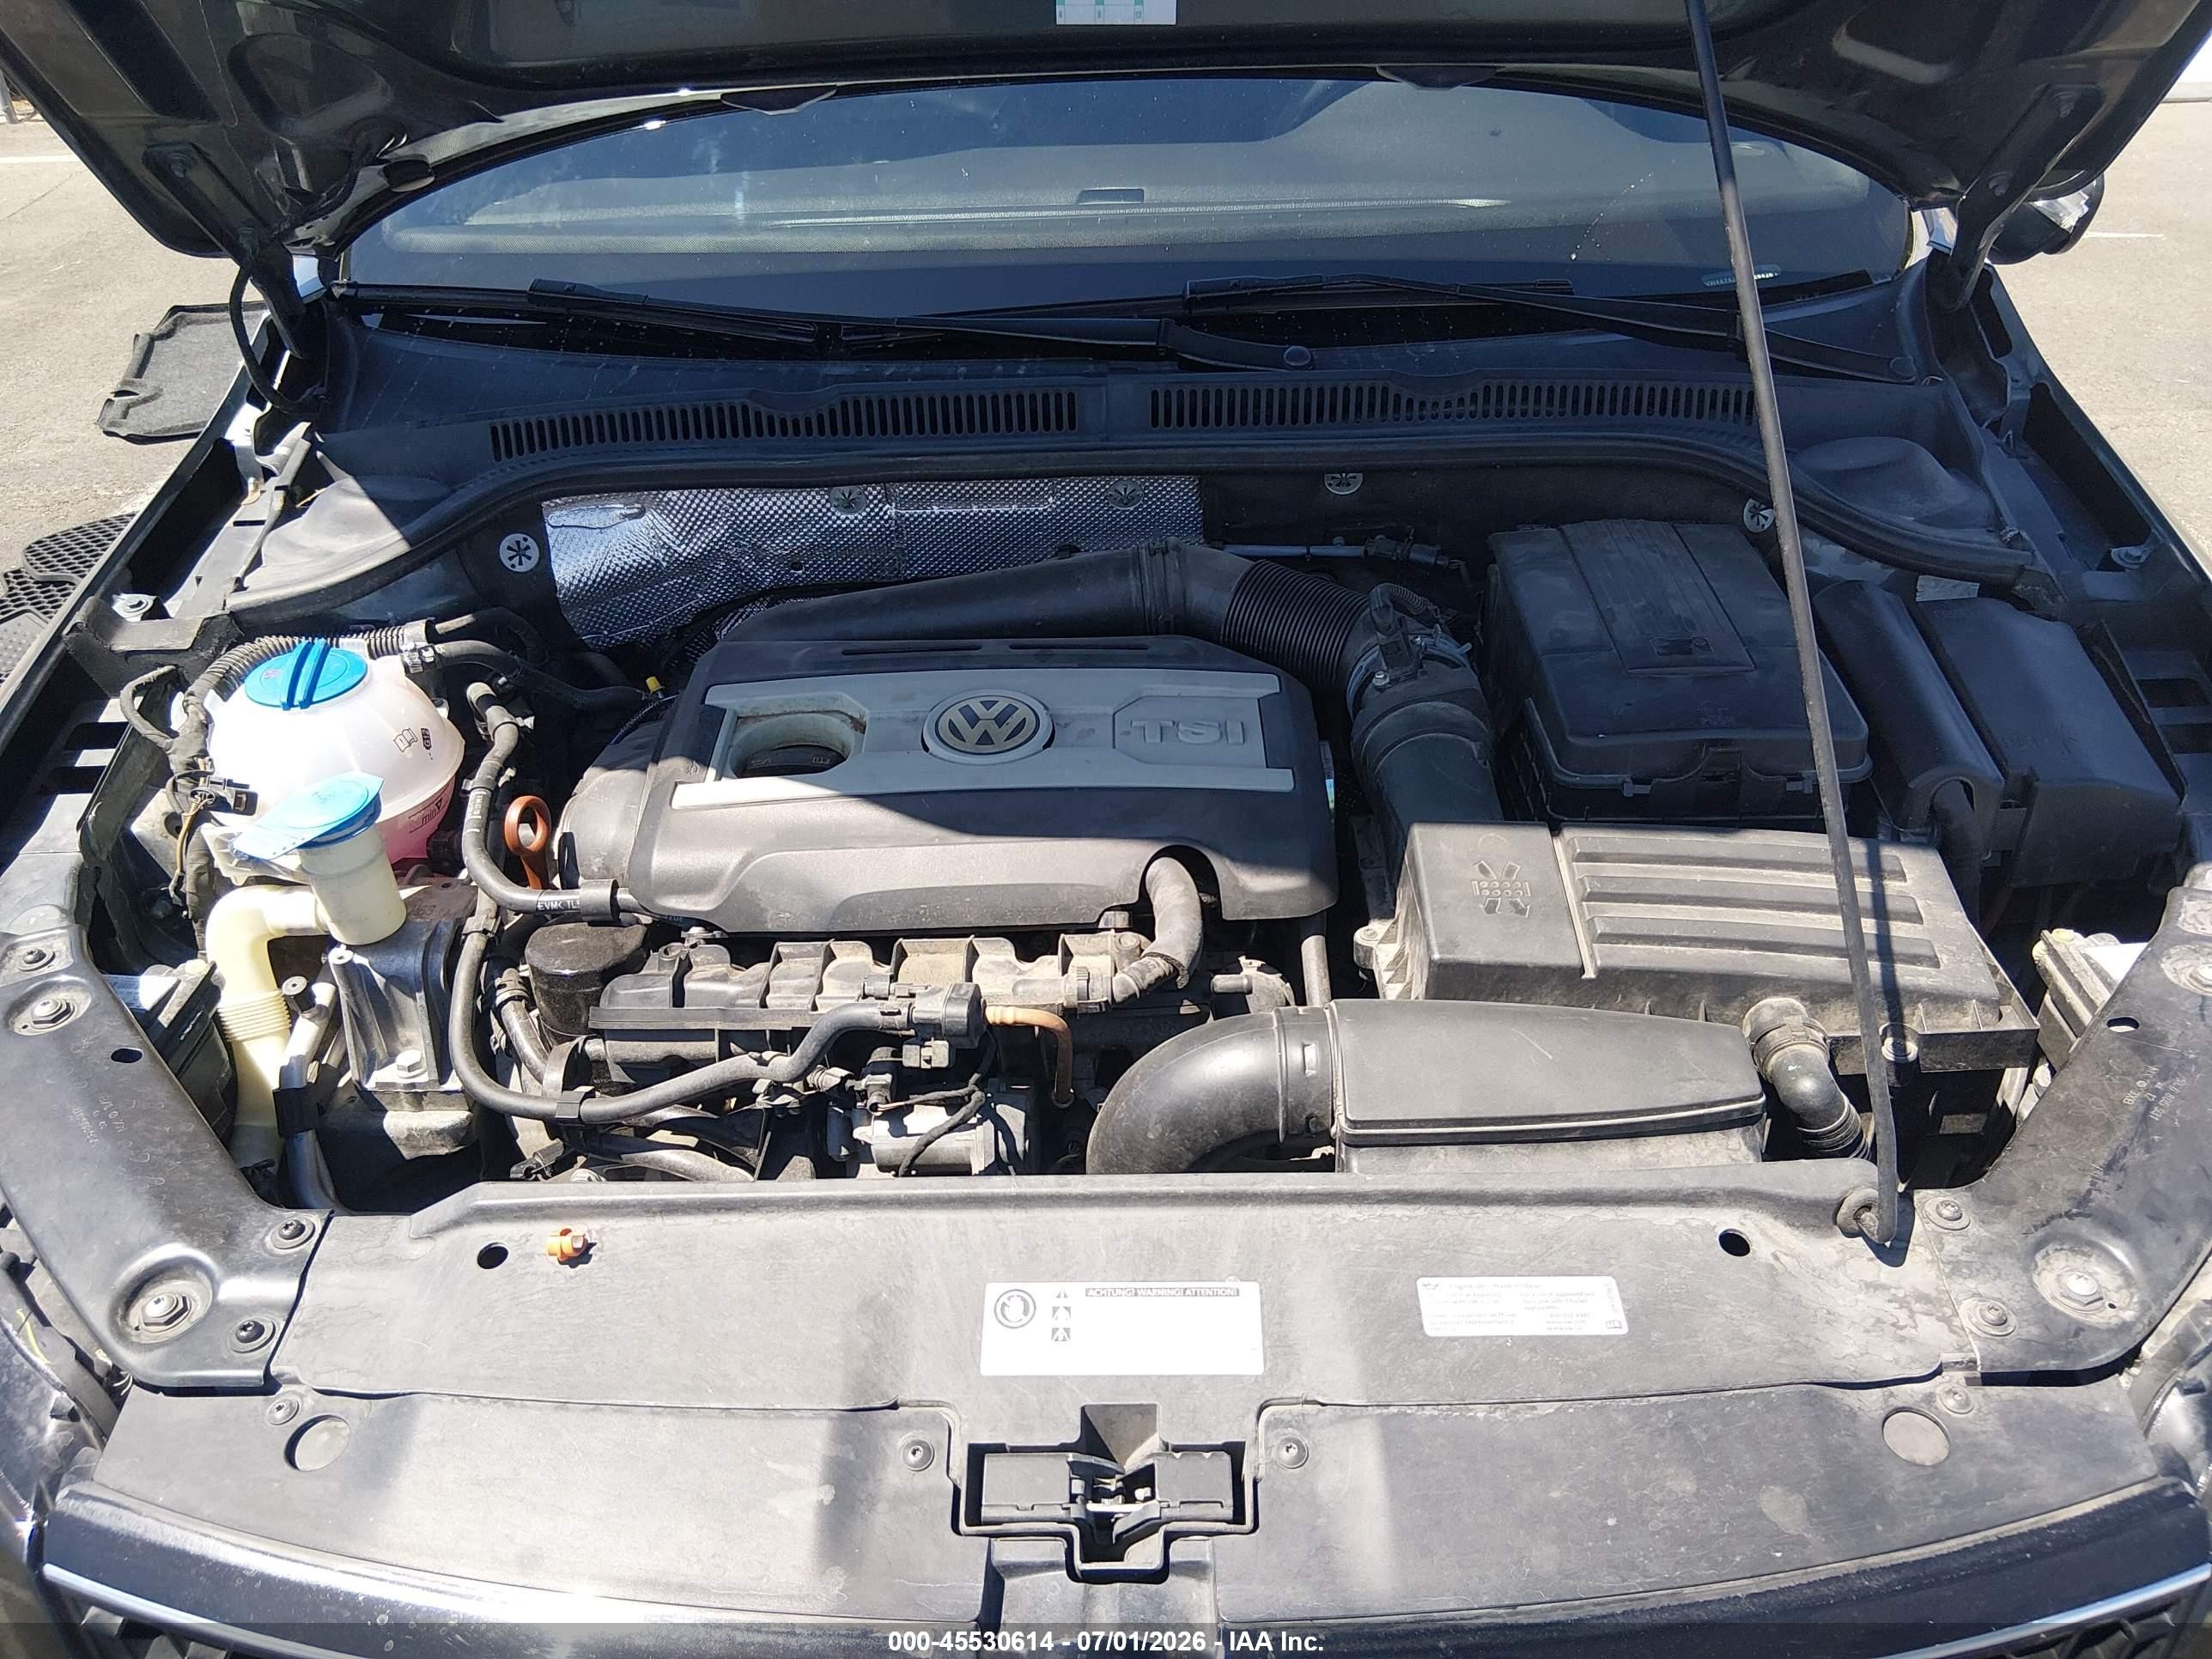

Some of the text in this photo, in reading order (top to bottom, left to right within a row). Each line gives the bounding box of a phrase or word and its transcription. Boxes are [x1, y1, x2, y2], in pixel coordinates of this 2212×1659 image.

[935, 694, 1040, 756] VW
[1130, 720, 1245, 744] TSI
[421, 728, 432, 750] G12
[1087, 1288, 1237, 1297] ACHTUNG! WARNING! ATTENTION!
